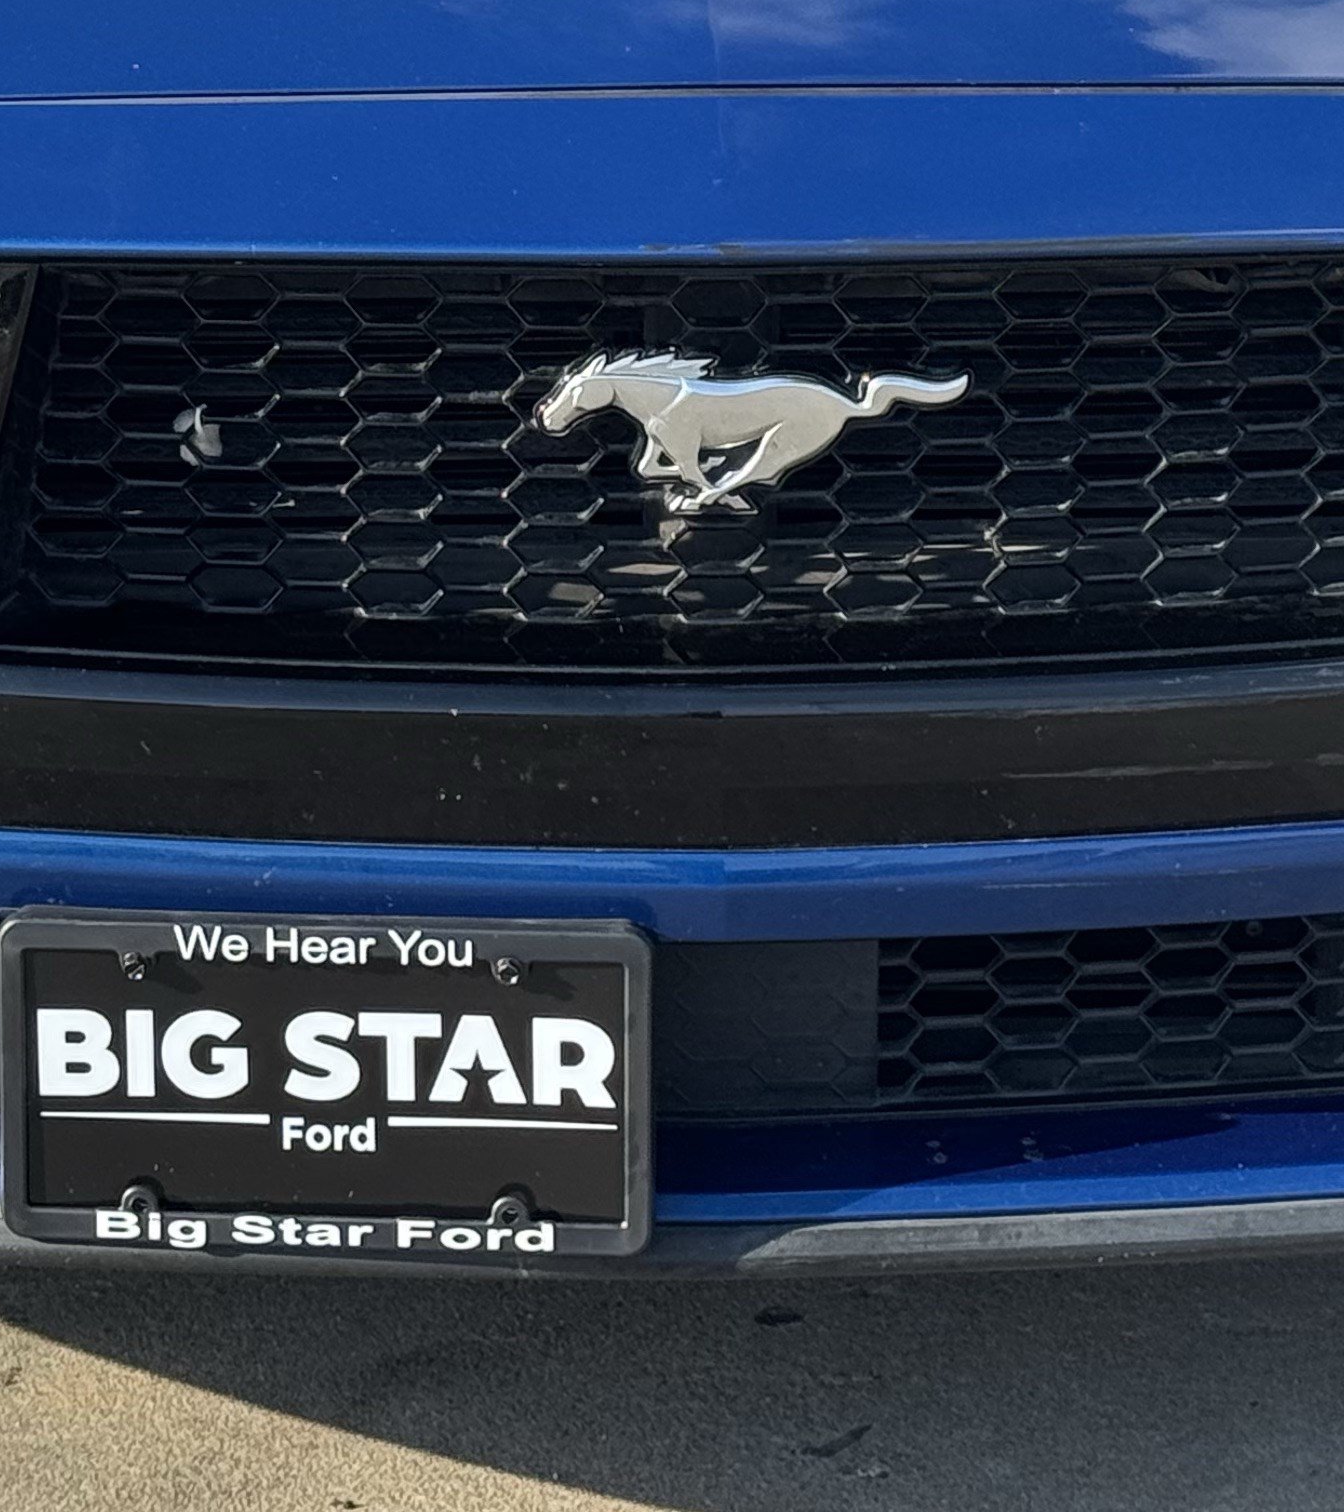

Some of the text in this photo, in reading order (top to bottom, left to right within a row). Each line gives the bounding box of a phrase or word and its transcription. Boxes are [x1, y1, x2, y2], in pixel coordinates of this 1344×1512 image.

[173, 925, 473, 968] We Hear You
[36, 1007, 617, 1110] BIG STAR
[281, 1116, 377, 1153] Ford
[95, 1209, 555, 1253] Big Star Ford
